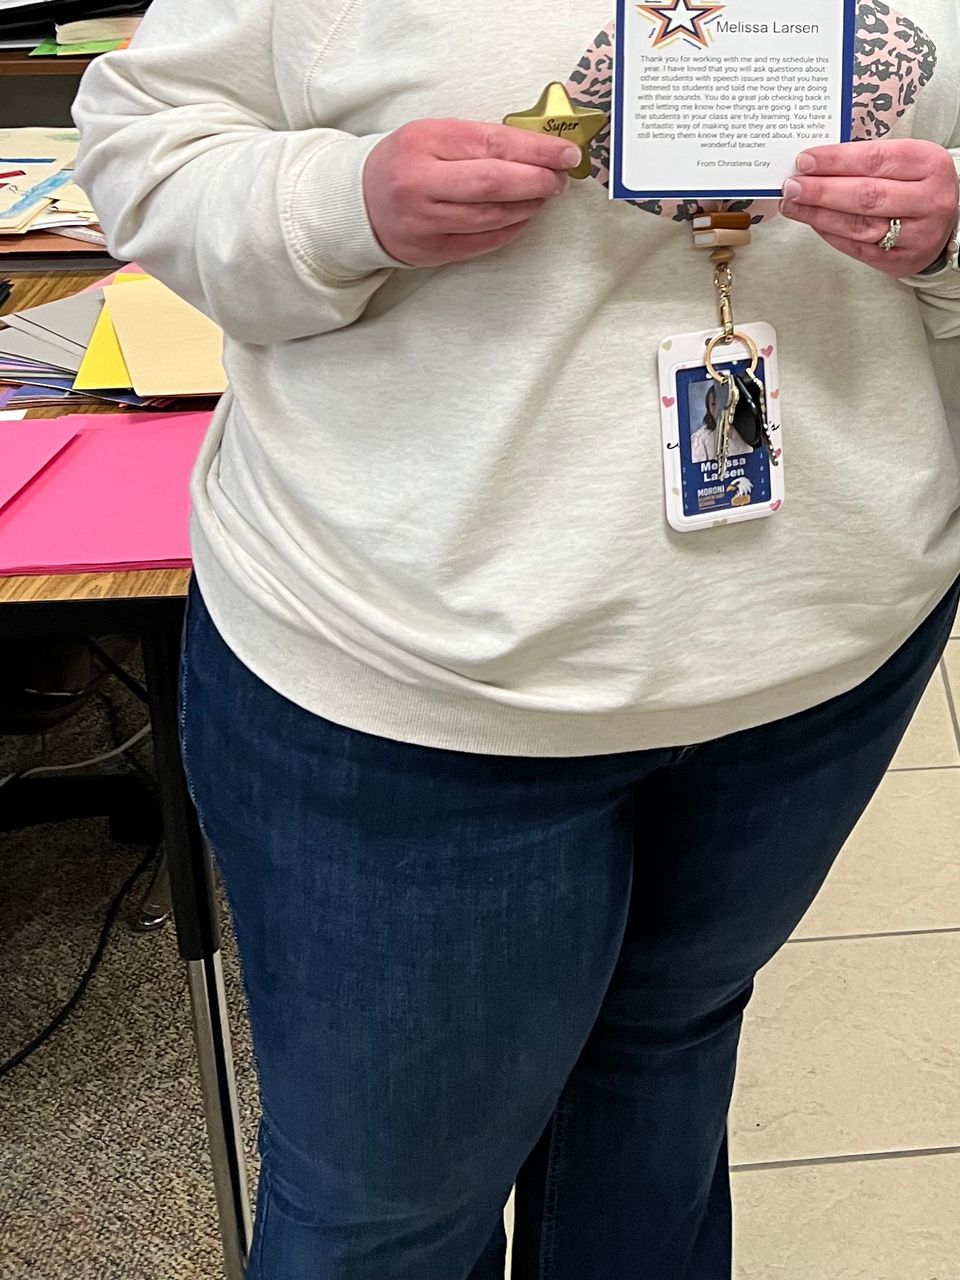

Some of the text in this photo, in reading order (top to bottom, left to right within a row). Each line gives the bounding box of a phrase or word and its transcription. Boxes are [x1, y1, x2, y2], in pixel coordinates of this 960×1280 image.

[717, 21, 818, 34] Melissa Larsen
[542, 119, 579, 137] Super
[754, 160, 770, 168] Gray
[700, 458, 746, 472] Messa
[703, 468, 744, 482] Lasen
[697, 485, 725, 497] MORONI
